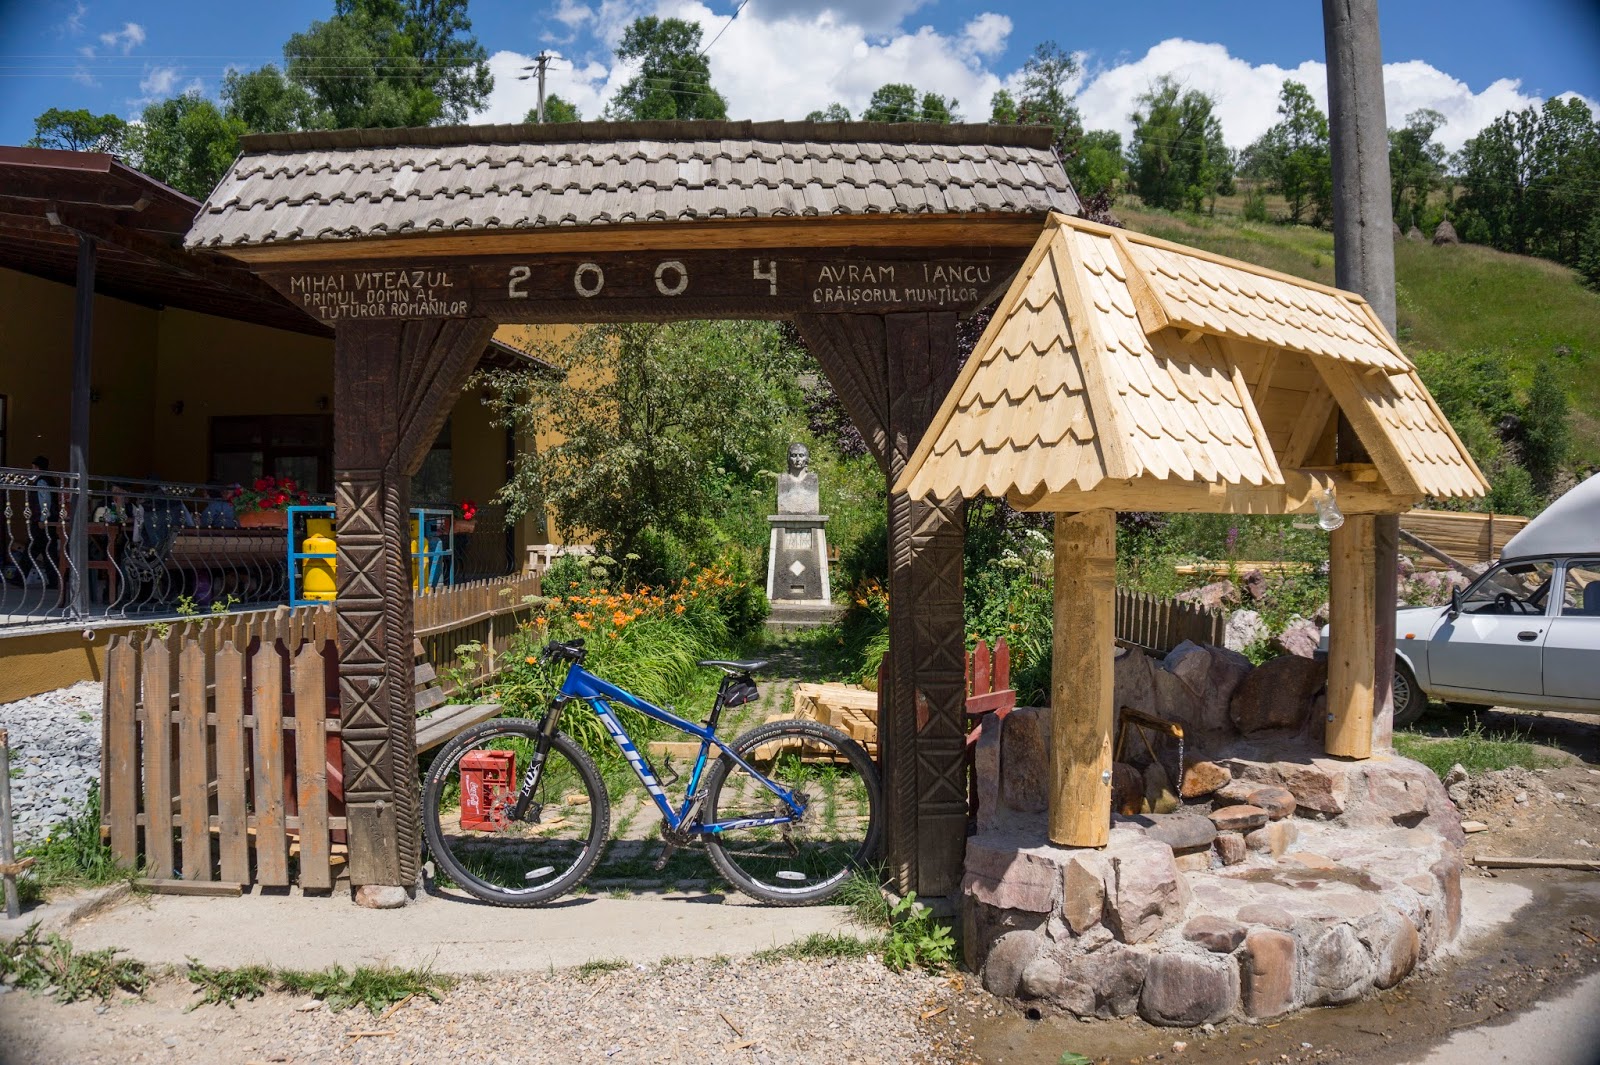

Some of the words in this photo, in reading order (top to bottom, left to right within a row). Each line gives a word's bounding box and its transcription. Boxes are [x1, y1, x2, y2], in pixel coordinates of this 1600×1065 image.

[290, 274, 345, 294] MIHAI
[354, 270, 454, 290] VITEAZUL
[818, 265, 895, 283] AVRAM
[303, 291, 359, 307] PRIMUL
[366, 289, 410, 303] DOMN
[415, 288, 438, 302] AL
[319, 303, 386, 319] TUTUROR
[741, 729, 782, 750] HUTCHINSON
[434, 745, 462, 780] HUTCHINSON
[599, 713, 663, 796] FUJI
